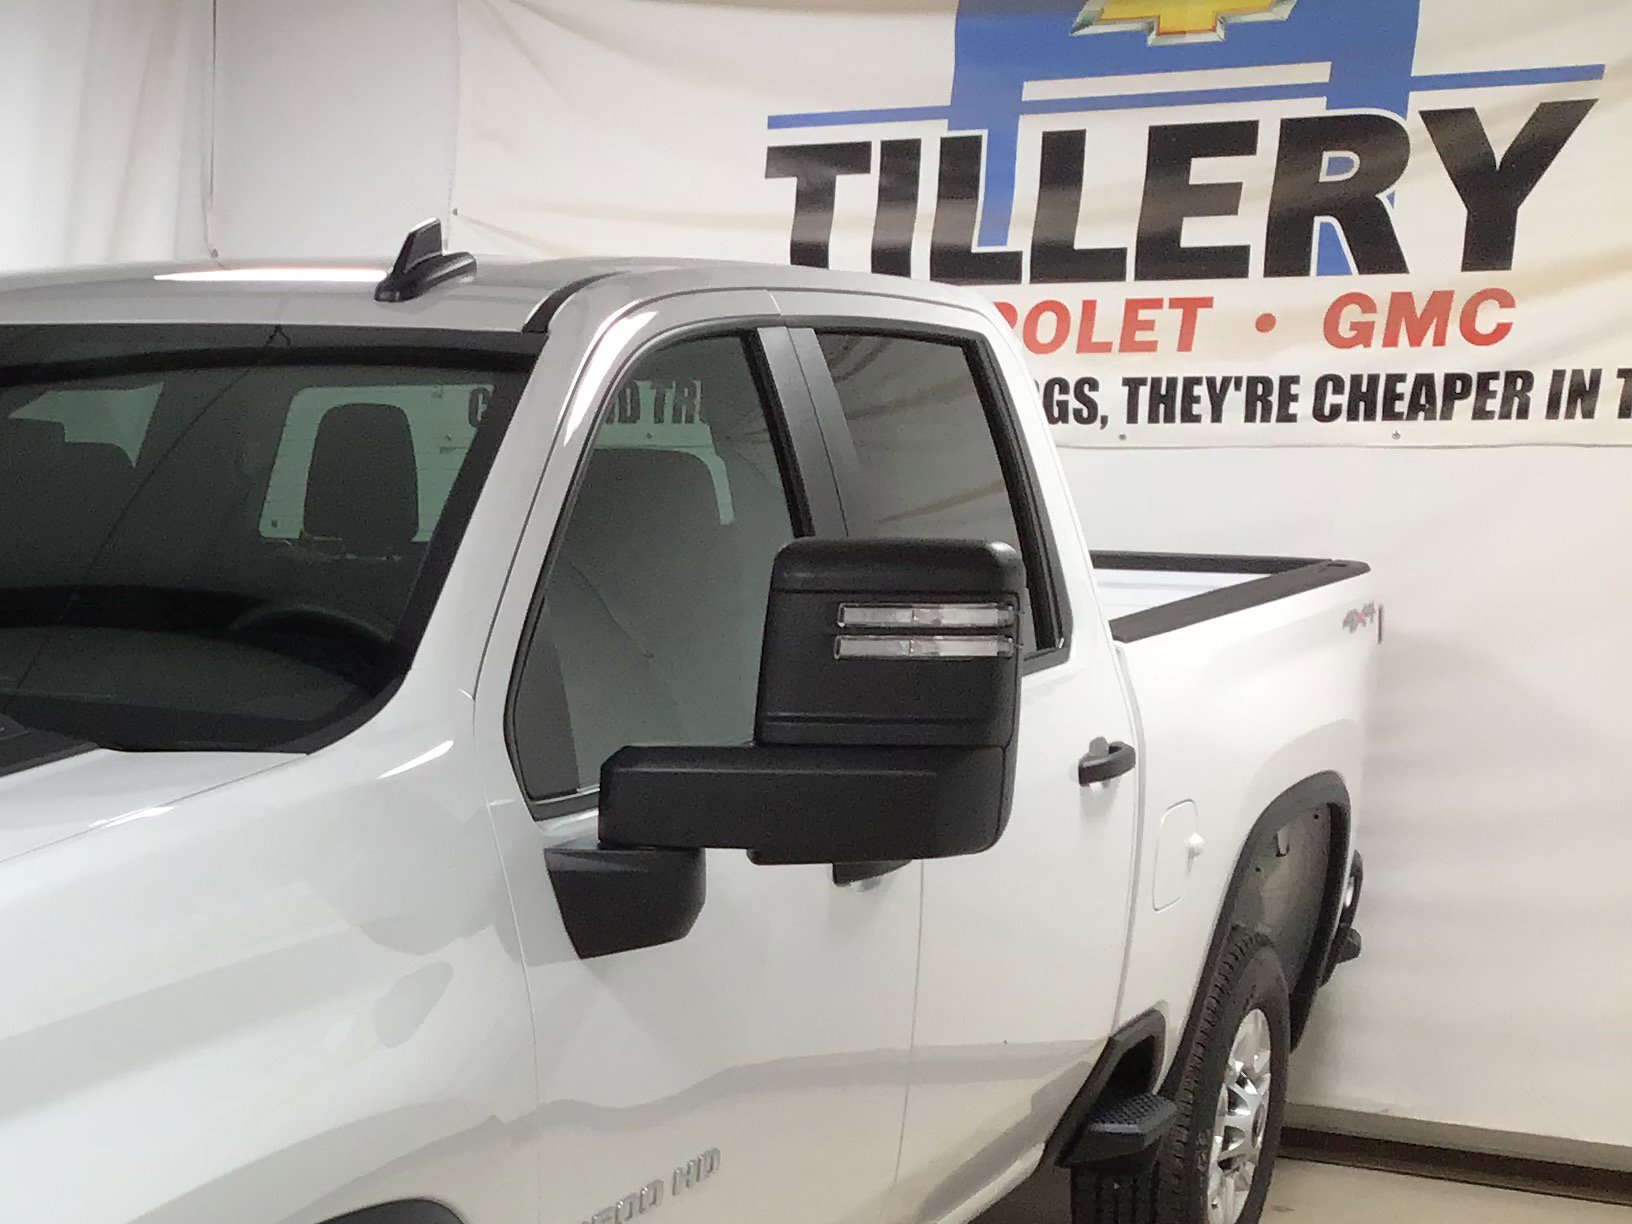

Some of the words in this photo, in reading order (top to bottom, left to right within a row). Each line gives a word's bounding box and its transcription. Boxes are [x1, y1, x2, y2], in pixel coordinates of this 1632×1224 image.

[765, 98, 1599, 285] TILLERY
[1323, 288, 1516, 349] GMC
[1122, 375, 1301, 425] THEY'RE
[1312, 370, 1534, 423] CHEAPER
[1545, 368, 1603, 421] IN
